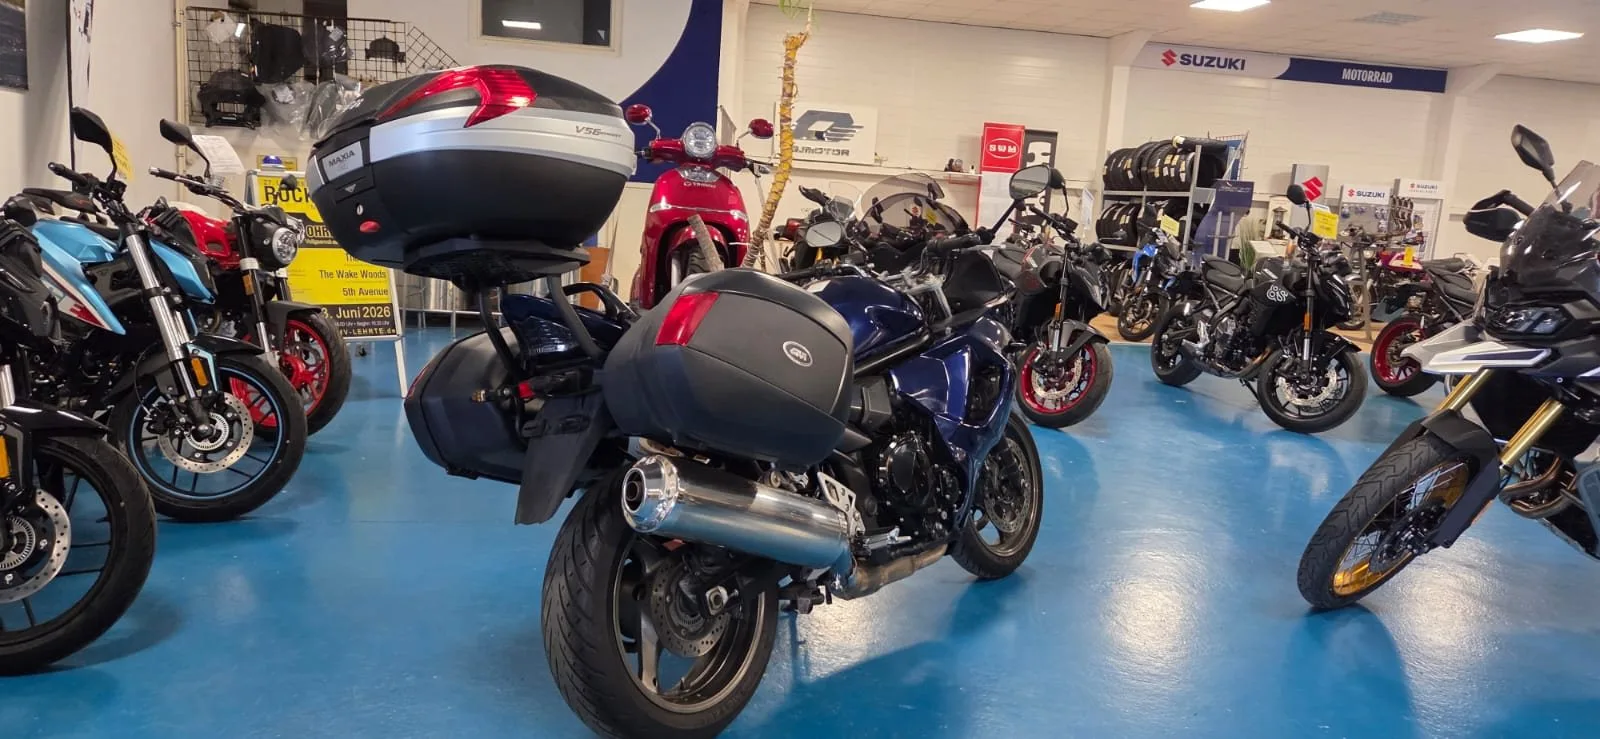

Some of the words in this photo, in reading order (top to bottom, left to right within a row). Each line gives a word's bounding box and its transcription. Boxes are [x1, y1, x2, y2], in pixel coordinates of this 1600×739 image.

[1179, 53, 1245, 71] SUZUKI
[1341, 68, 1393, 84] MOTORRAD
[328, 150, 356, 167] MAXIA
[1356, 190, 1385, 198] SUZUKI
[319, 269, 334, 279] The
[336, 269, 358, 279] Wake
[360, 269, 387, 279] Woods
[343, 287, 356, 296] 5th
[359, 287, 389, 296] Avenue
[336, 306, 361, 319] Juni
[362, 306, 391, 318] 2026
